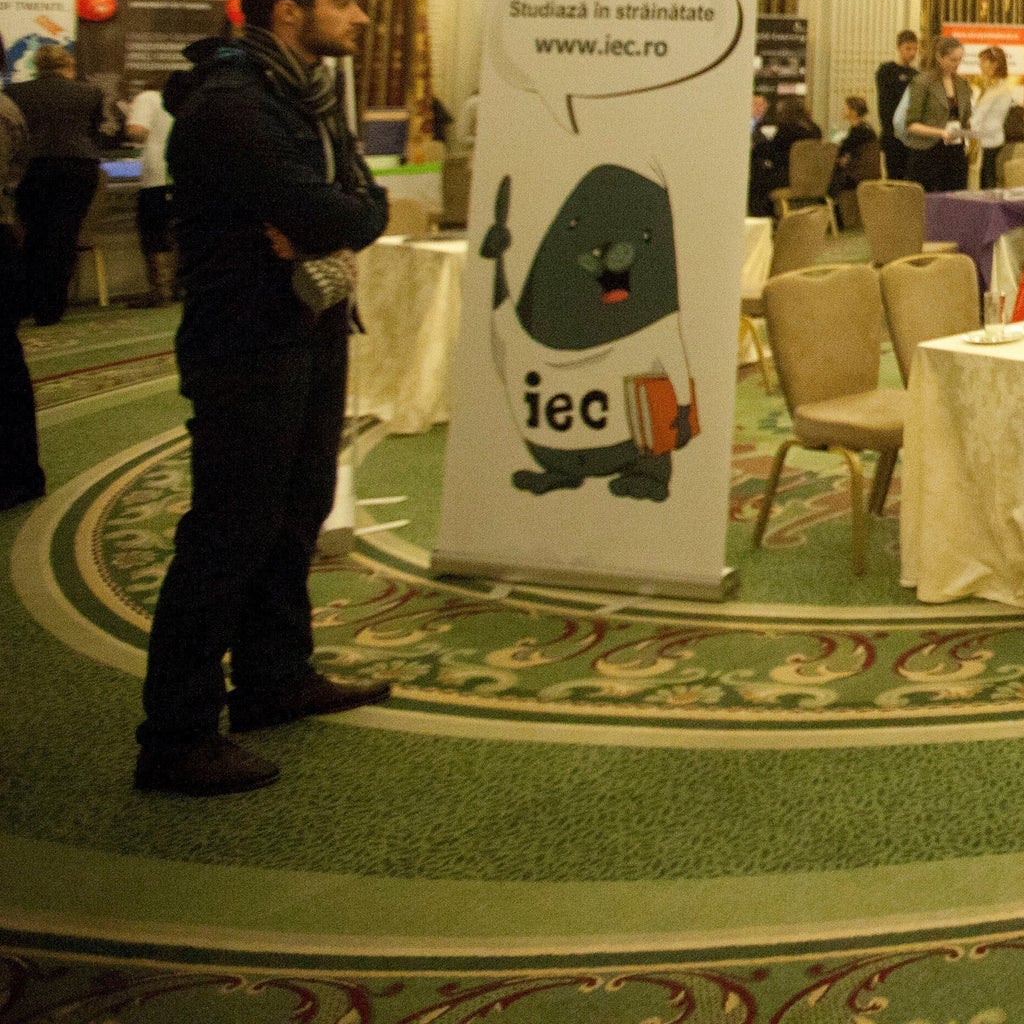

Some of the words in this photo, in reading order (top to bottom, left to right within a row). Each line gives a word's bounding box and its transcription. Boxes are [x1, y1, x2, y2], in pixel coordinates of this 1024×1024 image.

[509, 0, 587, 19] Studiază
[615, 3, 715, 22] străinătate
[534, 34, 669, 57] www.iec.ro
[524, 371, 609, 432] iec
